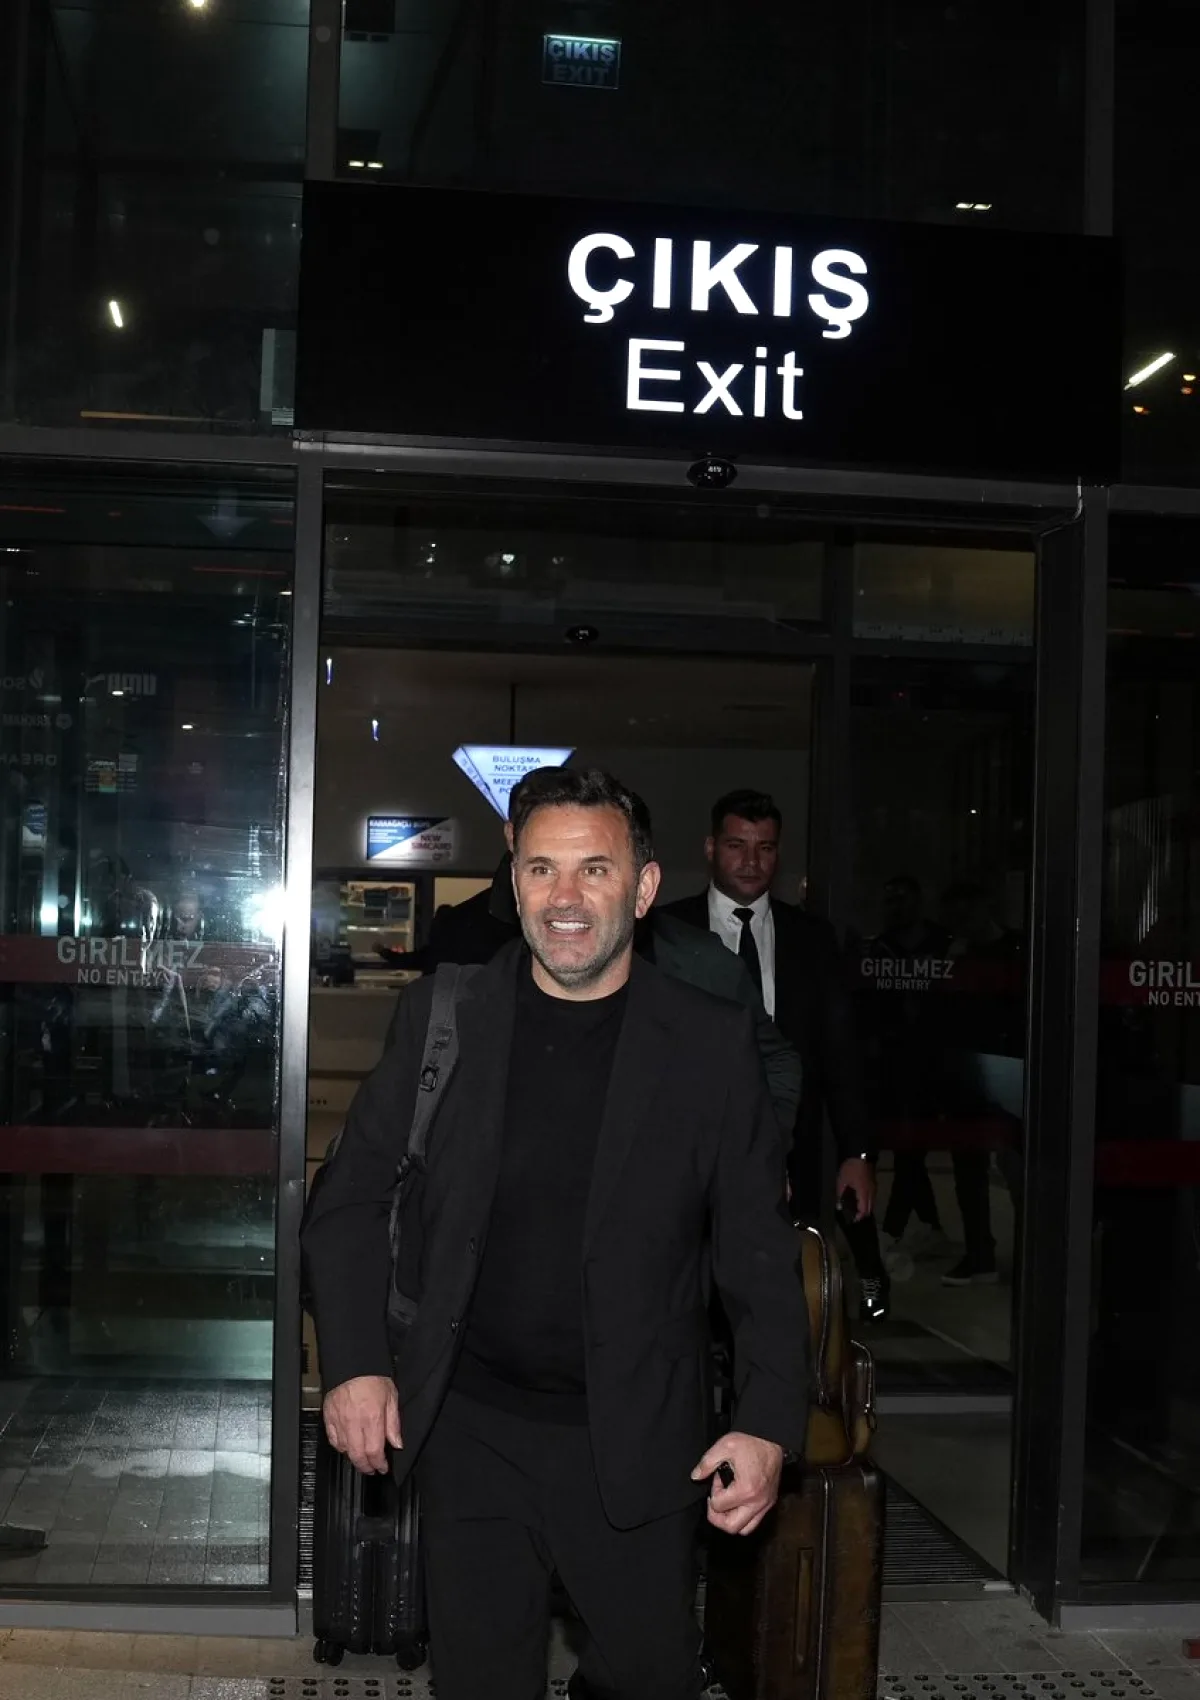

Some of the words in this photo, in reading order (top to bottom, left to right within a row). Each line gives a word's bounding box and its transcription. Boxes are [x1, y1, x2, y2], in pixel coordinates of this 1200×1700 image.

[547, 40, 616, 67] ÇIKIŞ
[553, 64, 609, 85] EXIT
[567, 232, 869, 339] ÇIKIŞ
[626, 338, 804, 420] Exit
[492, 755, 541, 764] BULUŞMA
[77, 968, 101, 984] NO
[105, 969, 164, 988] ENTRY
[876, 978, 892, 991] NO
[894, 979, 932, 991] ENTRY
[1148, 990, 1170, 1006] NO
